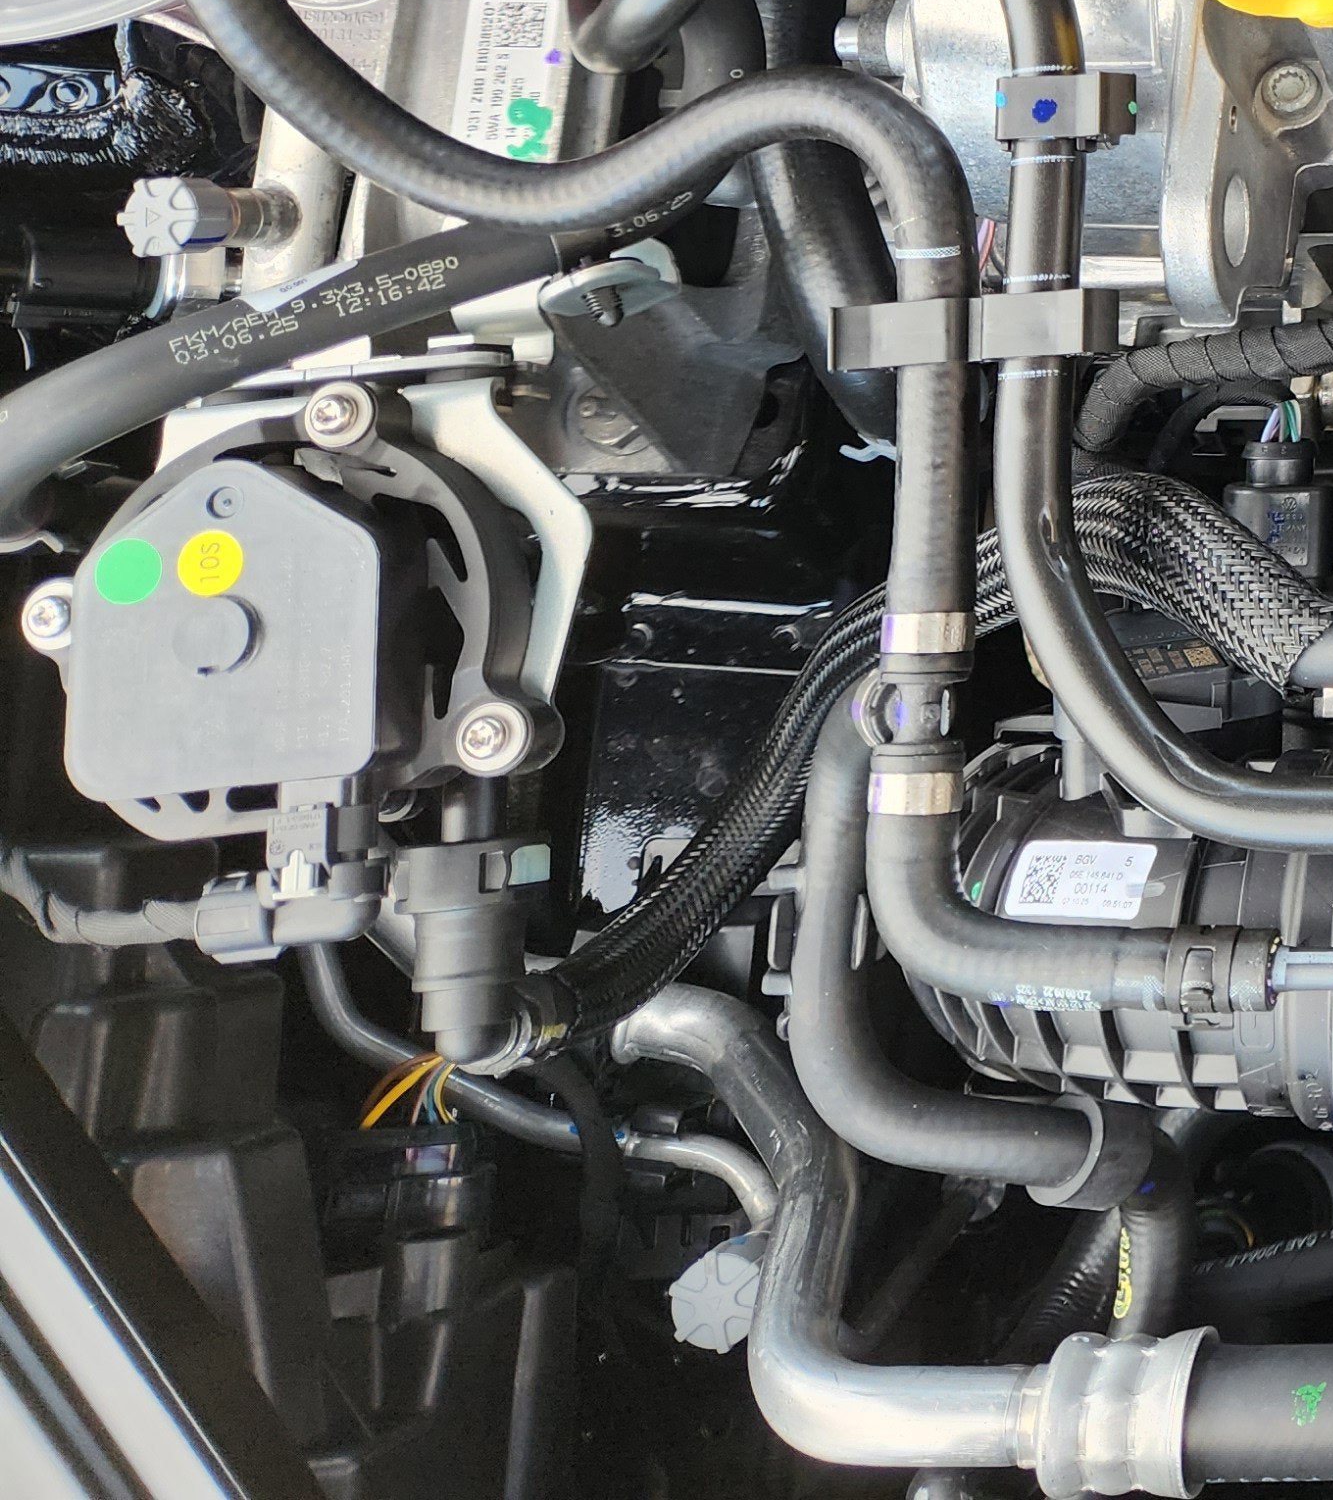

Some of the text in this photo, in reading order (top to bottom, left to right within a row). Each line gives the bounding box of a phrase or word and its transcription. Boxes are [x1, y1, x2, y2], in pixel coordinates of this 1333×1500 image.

[334, 273, 447, 318] 12:16:42
[1075, 855, 1134, 867] BGV 5
